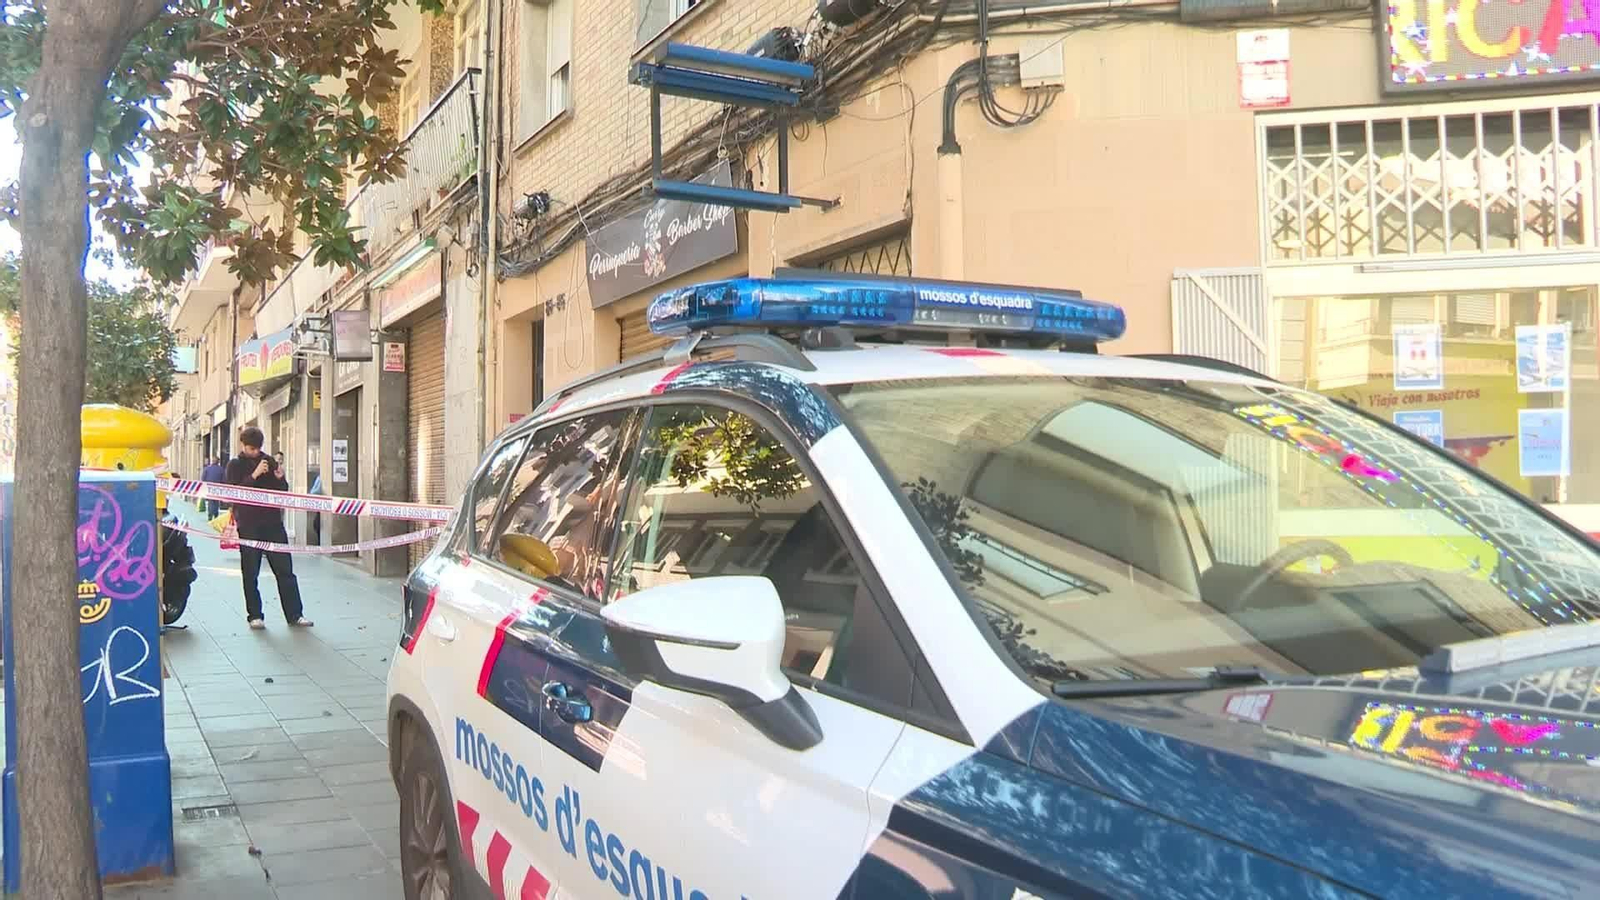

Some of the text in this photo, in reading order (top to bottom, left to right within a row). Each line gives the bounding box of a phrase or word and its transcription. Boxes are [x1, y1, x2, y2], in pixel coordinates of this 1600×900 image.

[667, 215, 703, 246] Barber
[919, 289, 1034, 310] mossos d'esquadra
[1369, 393, 1399, 408] Viaja
[1402, 393, 1423, 405] con
[454, 716, 549, 832] mossos
